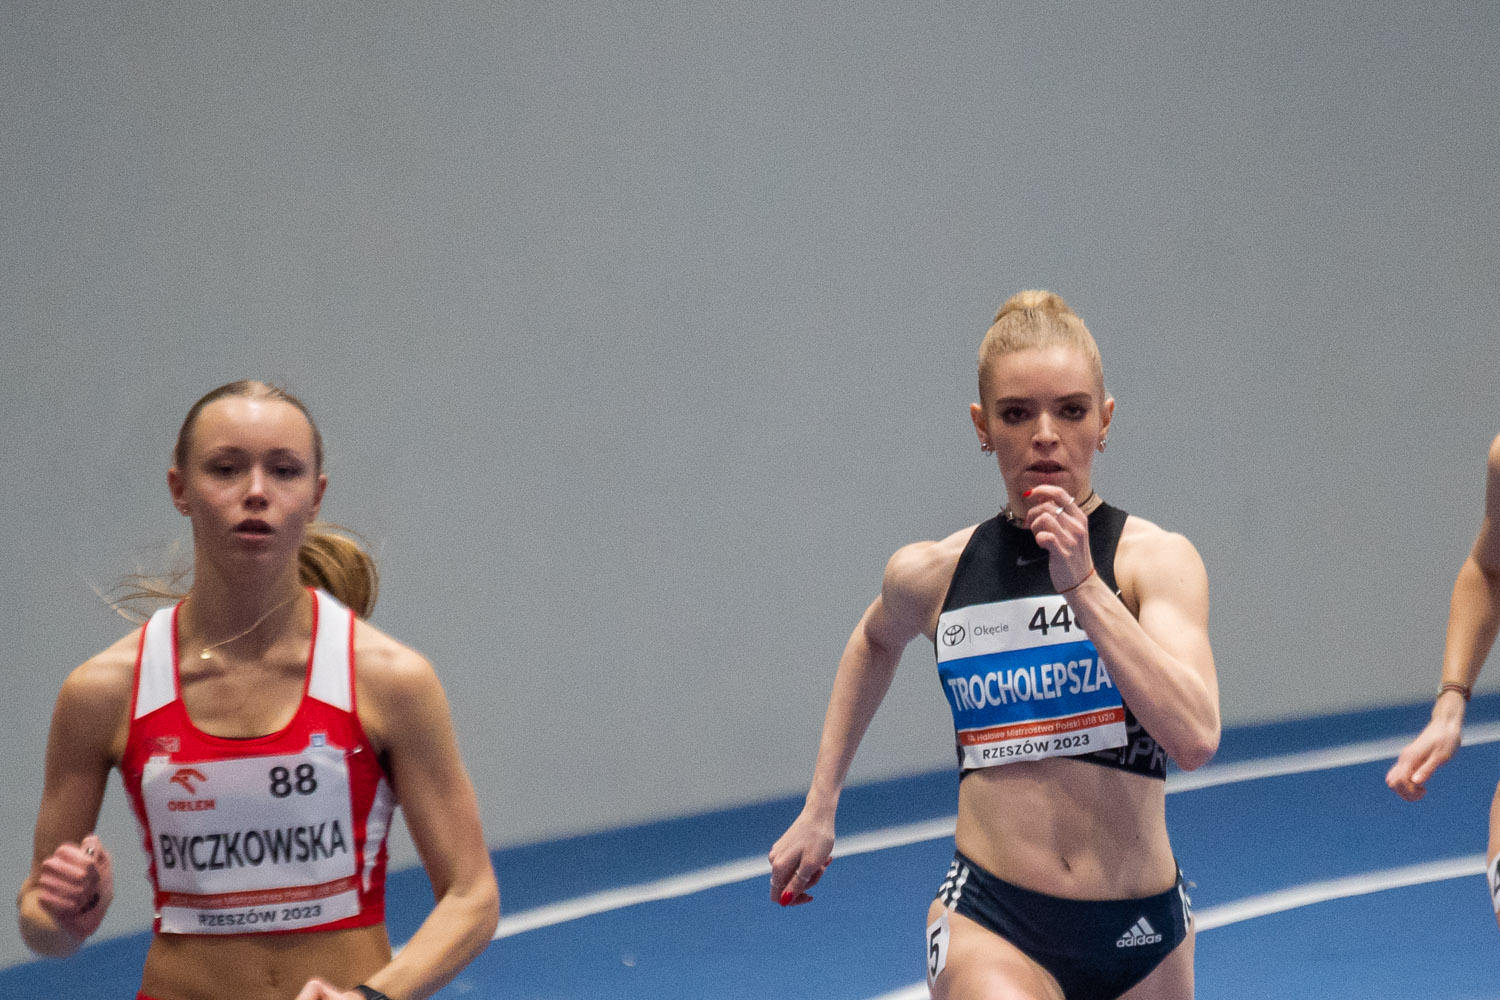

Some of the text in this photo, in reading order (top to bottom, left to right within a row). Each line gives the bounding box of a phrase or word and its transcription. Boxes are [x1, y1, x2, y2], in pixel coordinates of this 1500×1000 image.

[973, 623, 1009, 637] Okęcie
[947, 656, 1112, 712] TROCHOLEPSZA
[982, 734, 1090, 760] RZESZÓW 2023
[269, 764, 318, 798] 88
[159, 820, 347, 872] BYCZKOWSKA
[198, 905, 322, 928] RZESZÓW 2023
[929, 926, 942, 977] 5
[1116, 931, 1162, 948] adidas
